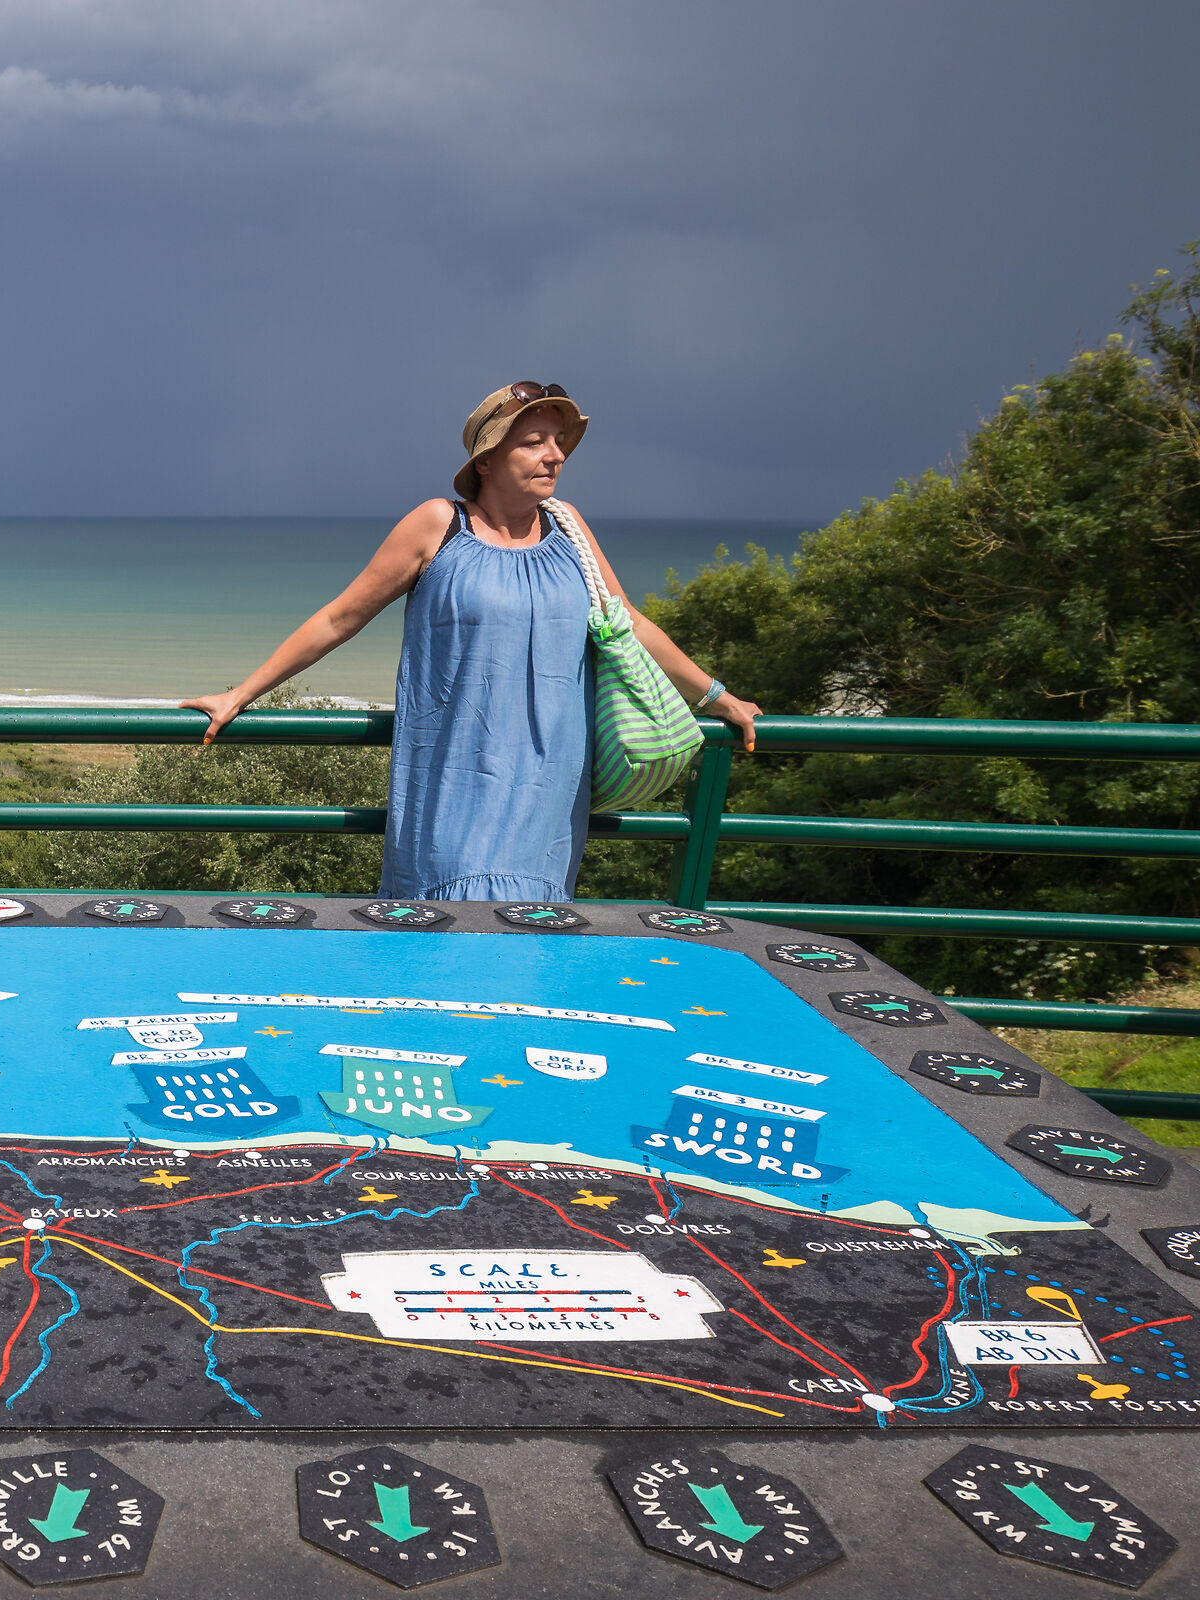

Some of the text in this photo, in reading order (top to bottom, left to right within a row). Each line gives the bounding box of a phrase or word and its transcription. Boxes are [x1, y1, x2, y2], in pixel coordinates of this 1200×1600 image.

[212, 995, 637, 1024] EASTERN NAVAL TASK FORCE
[194, 1013, 228, 1022] DIV
[142, 1036, 199, 1045] CORPS
[126, 1050, 232, 1062] BR 50 DIV
[336, 1046, 380, 1057] CDN
[413, 1053, 452, 1064] DIV
[538, 1061, 597, 1074] CORPS
[705, 1056, 728, 1066] BR
[770, 1068, 814, 1080] DIV
[694, 1089, 722, 1100] BR
[763, 1102, 807, 1115] DIV
[162, 1101, 279, 1122] GOLD
[345, 1097, 474, 1123] JUNO
[36, 1156, 187, 1167] ARROMANCHES
[216, 1158, 313, 1168] ASNELLES
[644, 1132, 823, 1181] SWORD
[351, 1171, 491, 1181] COURSEULLES
[506, 1170, 614, 1181] BERNIERES
[1104, 1167, 1139, 1177] KM
[30, 1208, 118, 1219] BAYEUX
[239, 1208, 348, 1223] SEULLES
[616, 1223, 732, 1236] DOUVRES
[805, 1239, 952, 1254] OUISTREHAM
[478, 1280, 540, 1290] MILES
[470, 1320, 615, 1331] KILOMETRES
[982, 1329, 1047, 1342] BR 6
[976, 1346, 1081, 1361] AB DIV
[788, 1377, 870, 1394] CAEN
[943, 1368, 970, 1407] ORNE
[988, 1399, 1200, 1413] ROBERT FOSTE
[317, 1469, 360, 1542] ST LO
[754, 1482, 801, 1517] KM
[433, 1480, 479, 1558] 31 KM
[631, 1459, 744, 1564] AVRANCHES
[1014, 1461, 1148, 1562] ST JAMES
[98, 1498, 144, 1560] 79 KM
[973, 1511, 1027, 1543] KM
